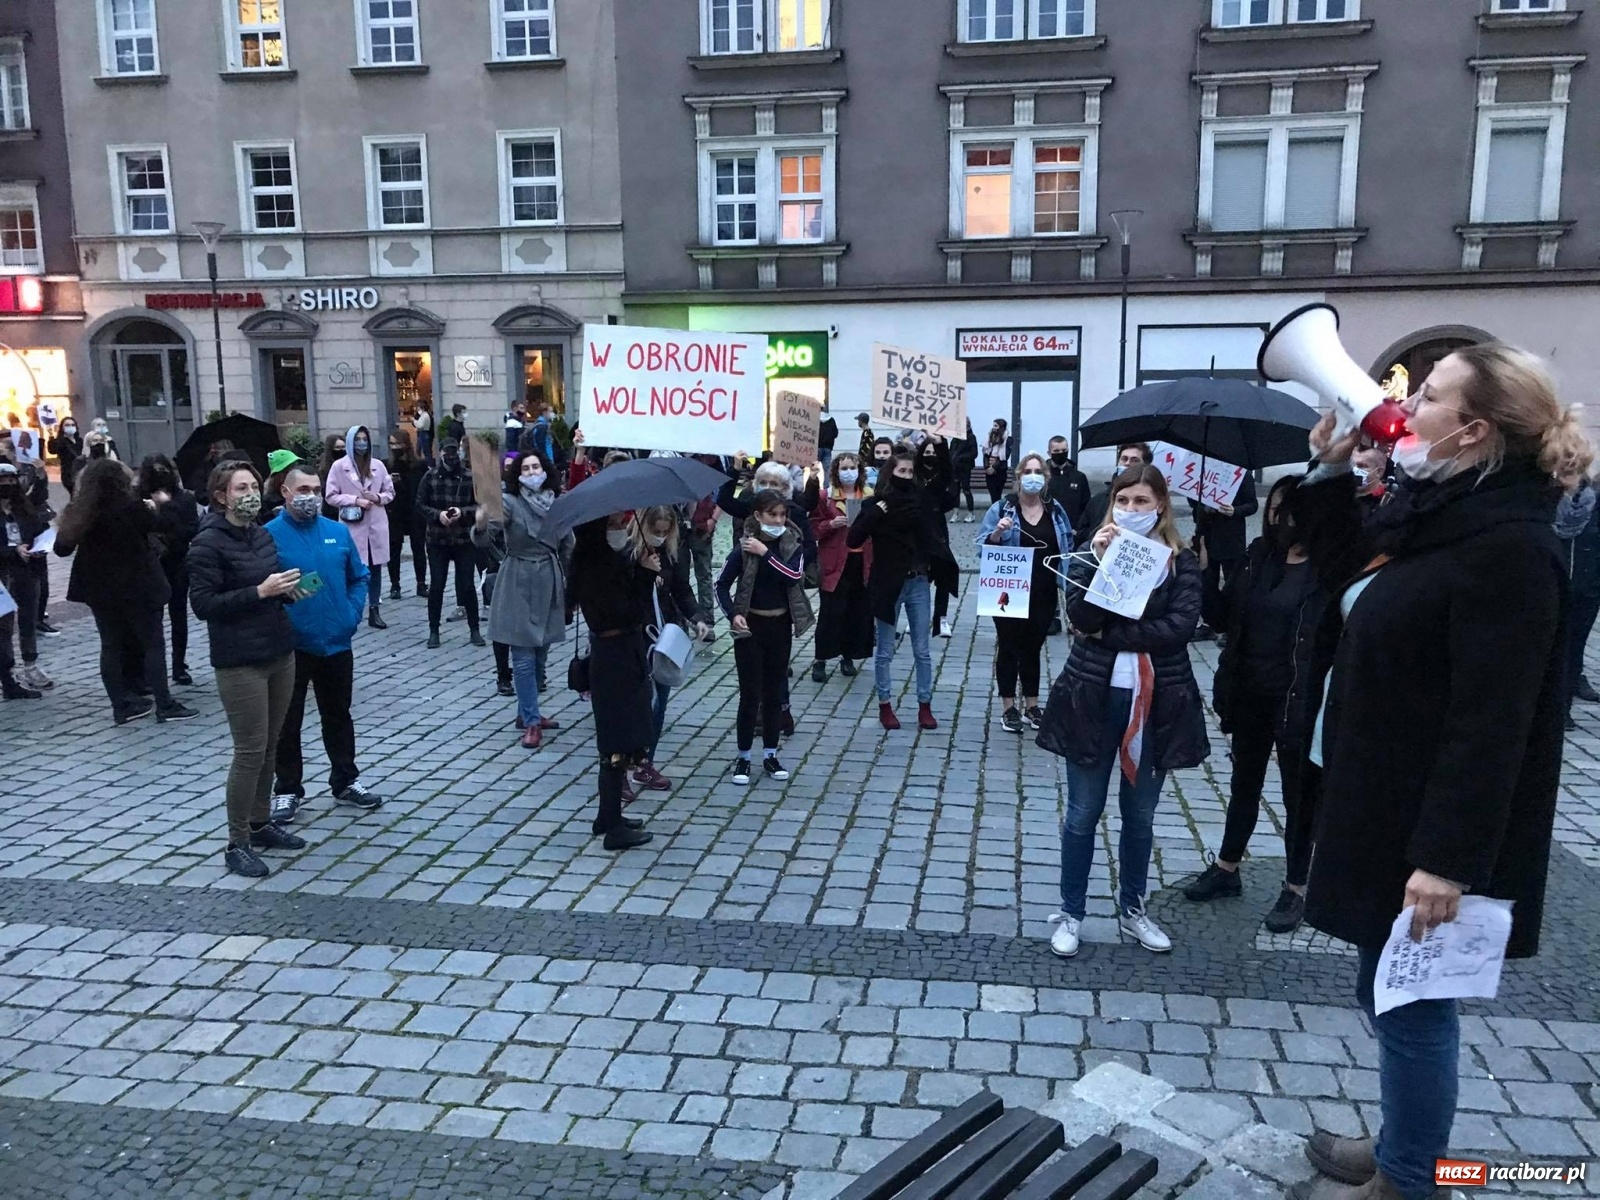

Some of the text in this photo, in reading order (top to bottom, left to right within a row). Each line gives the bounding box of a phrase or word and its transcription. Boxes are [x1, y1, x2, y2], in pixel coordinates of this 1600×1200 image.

[300, 286, 379, 311] SHIRO
[962, 334, 1028, 344] LOKAL DO
[962, 344, 1028, 353] WYNAJĘCIA
[590, 342, 748, 375] W OBRONIE
[881, 350, 940, 378] TWÓJ
[886, 372, 965, 400] BÓL JEST
[593, 380, 737, 421] WOLNOŚCI
[883, 389, 950, 414] LEPSZY
[882, 405, 912, 422] NIŻ
[795, 444, 814, 457] NAS
[987, 552, 1027, 562] POLSKA
[1141, 546, 1151, 555] NAS
[994, 565, 1018, 574] JEST
[980, 577, 1029, 592] KOBIETĄ
